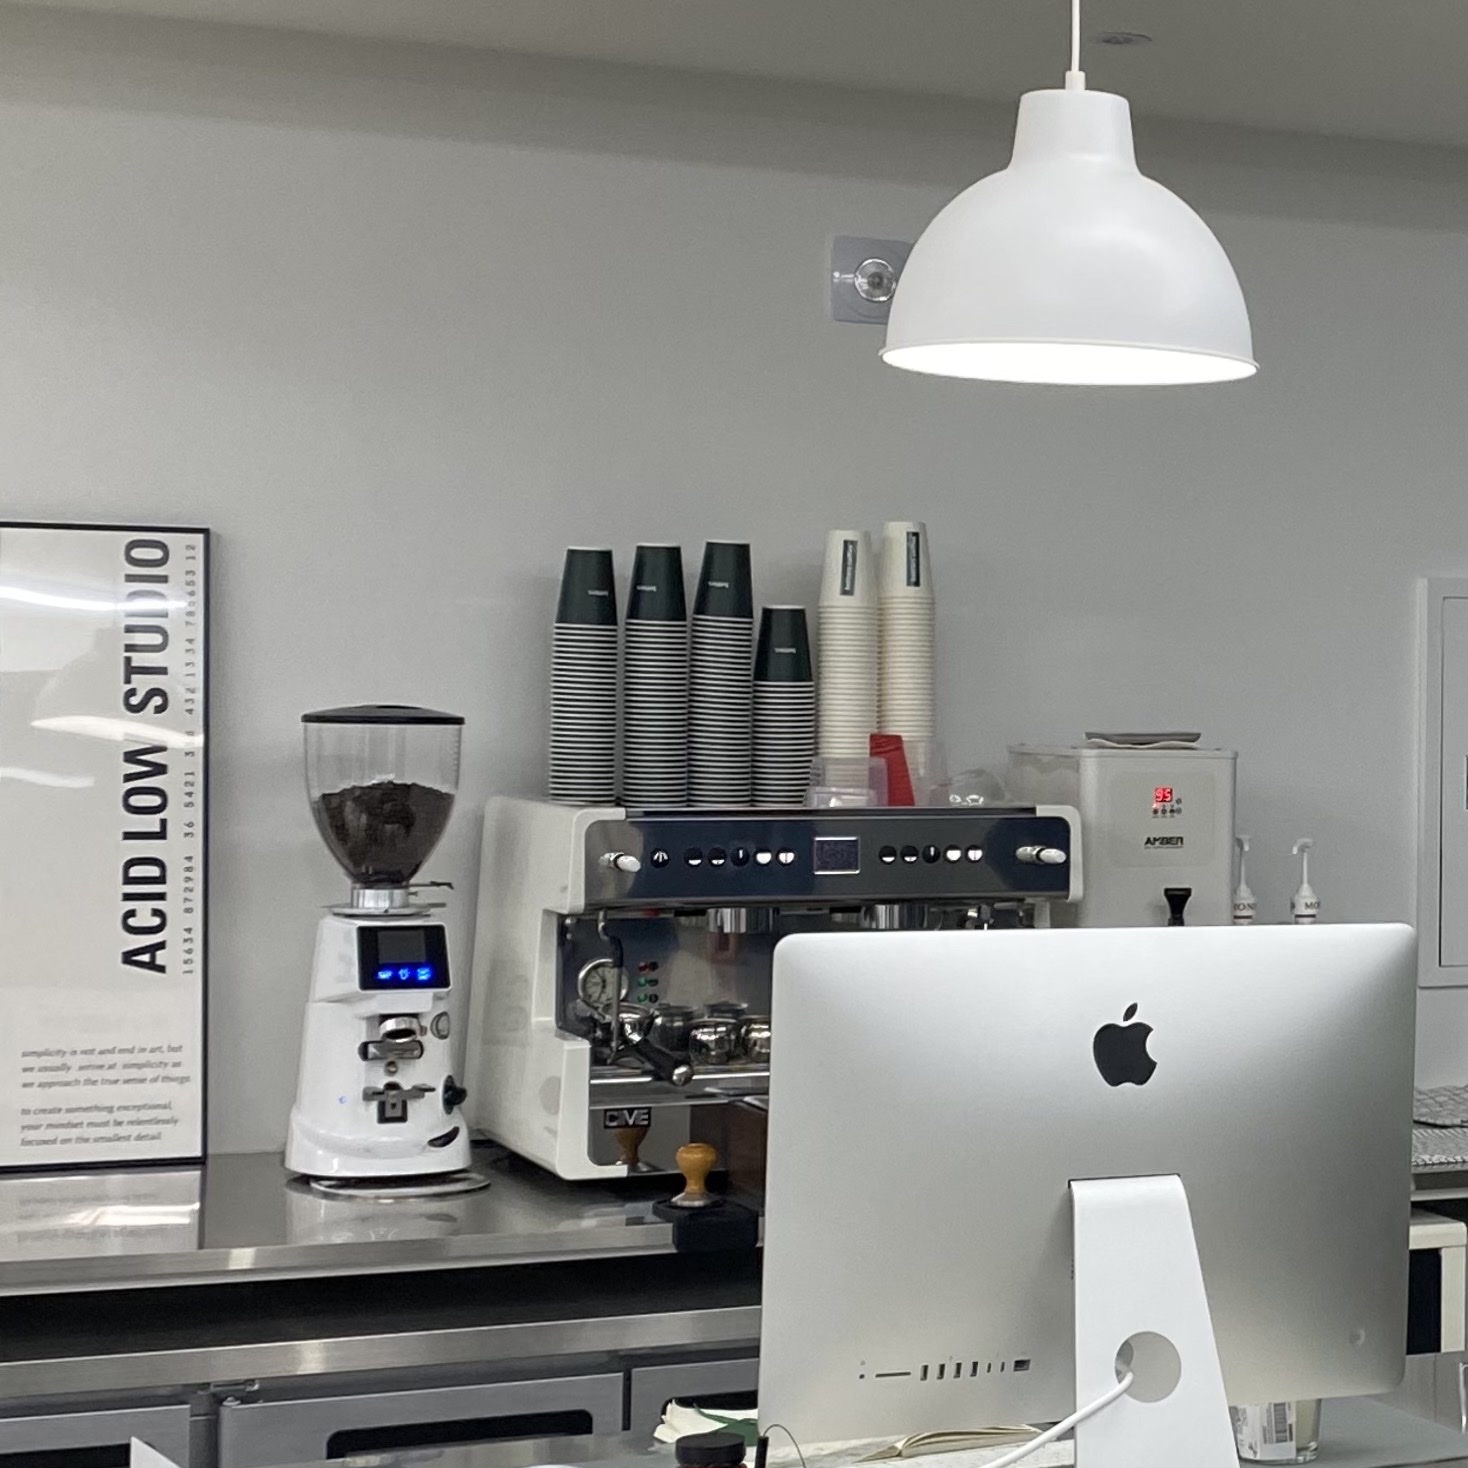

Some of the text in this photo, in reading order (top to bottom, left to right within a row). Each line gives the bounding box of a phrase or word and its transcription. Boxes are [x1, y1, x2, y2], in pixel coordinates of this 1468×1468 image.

[184, 544, 197, 561] 12
[184, 686, 196, 715] 432
[120, 538, 170, 975] ACID LOW STUDIO
[184, 771, 196, 808] 5421
[1155, 788, 1171, 802] 95
[184, 820, 195, 839] 36
[183, 855, 195, 914] 872984
[182, 926, 194, 975] 15634
